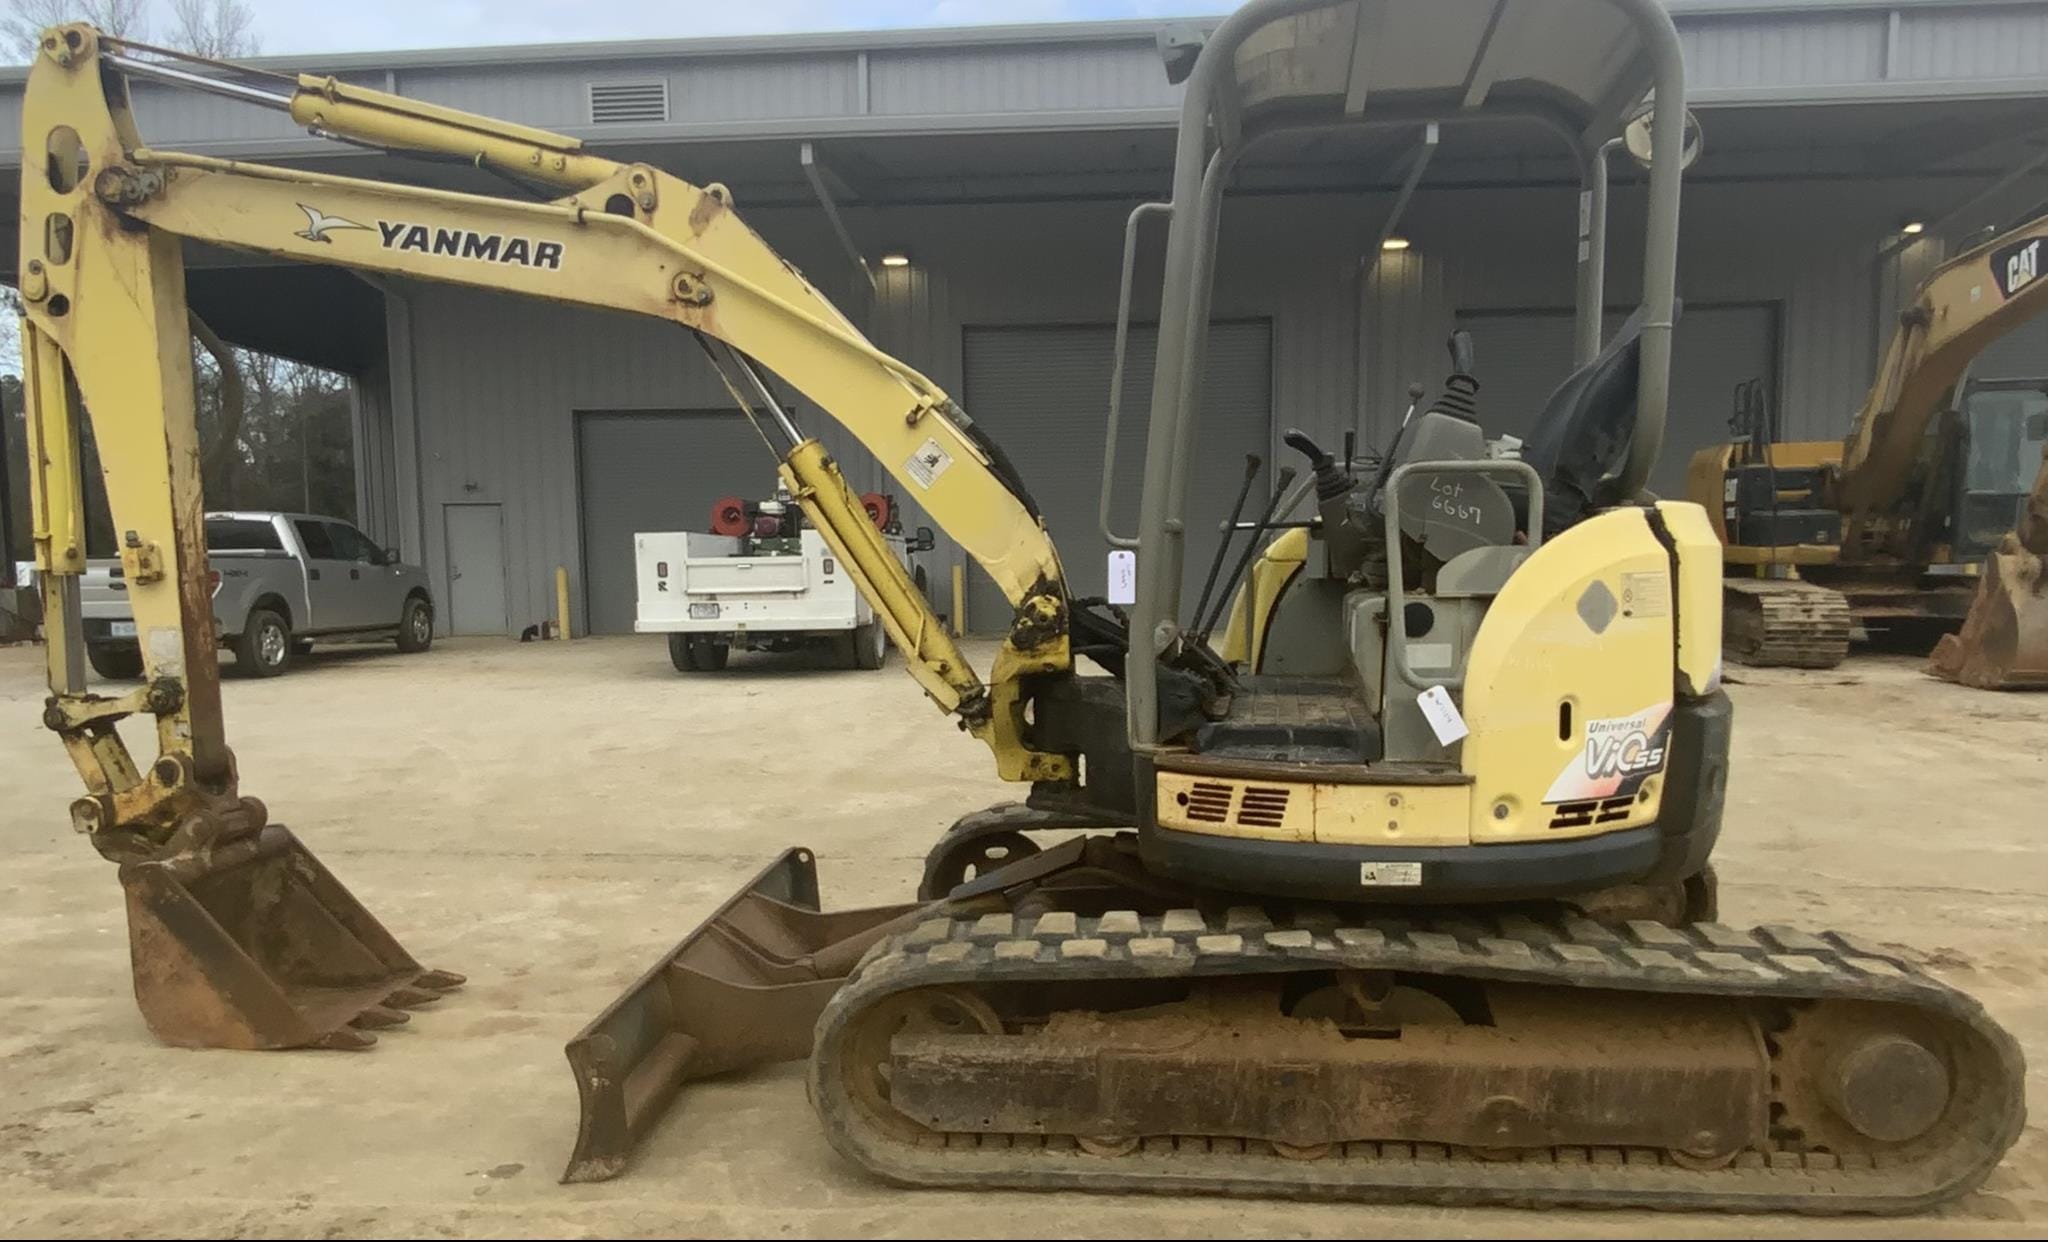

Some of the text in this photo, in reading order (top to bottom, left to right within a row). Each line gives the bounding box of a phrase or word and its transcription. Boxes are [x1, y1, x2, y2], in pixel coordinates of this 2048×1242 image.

[378, 221, 563, 269] YANMAR
[2007, 240, 2040, 293] CAT
[1431, 476, 1463, 497] Lot
[1432, 496, 1481, 524] 6667
[1589, 718, 1647, 733] Universal
